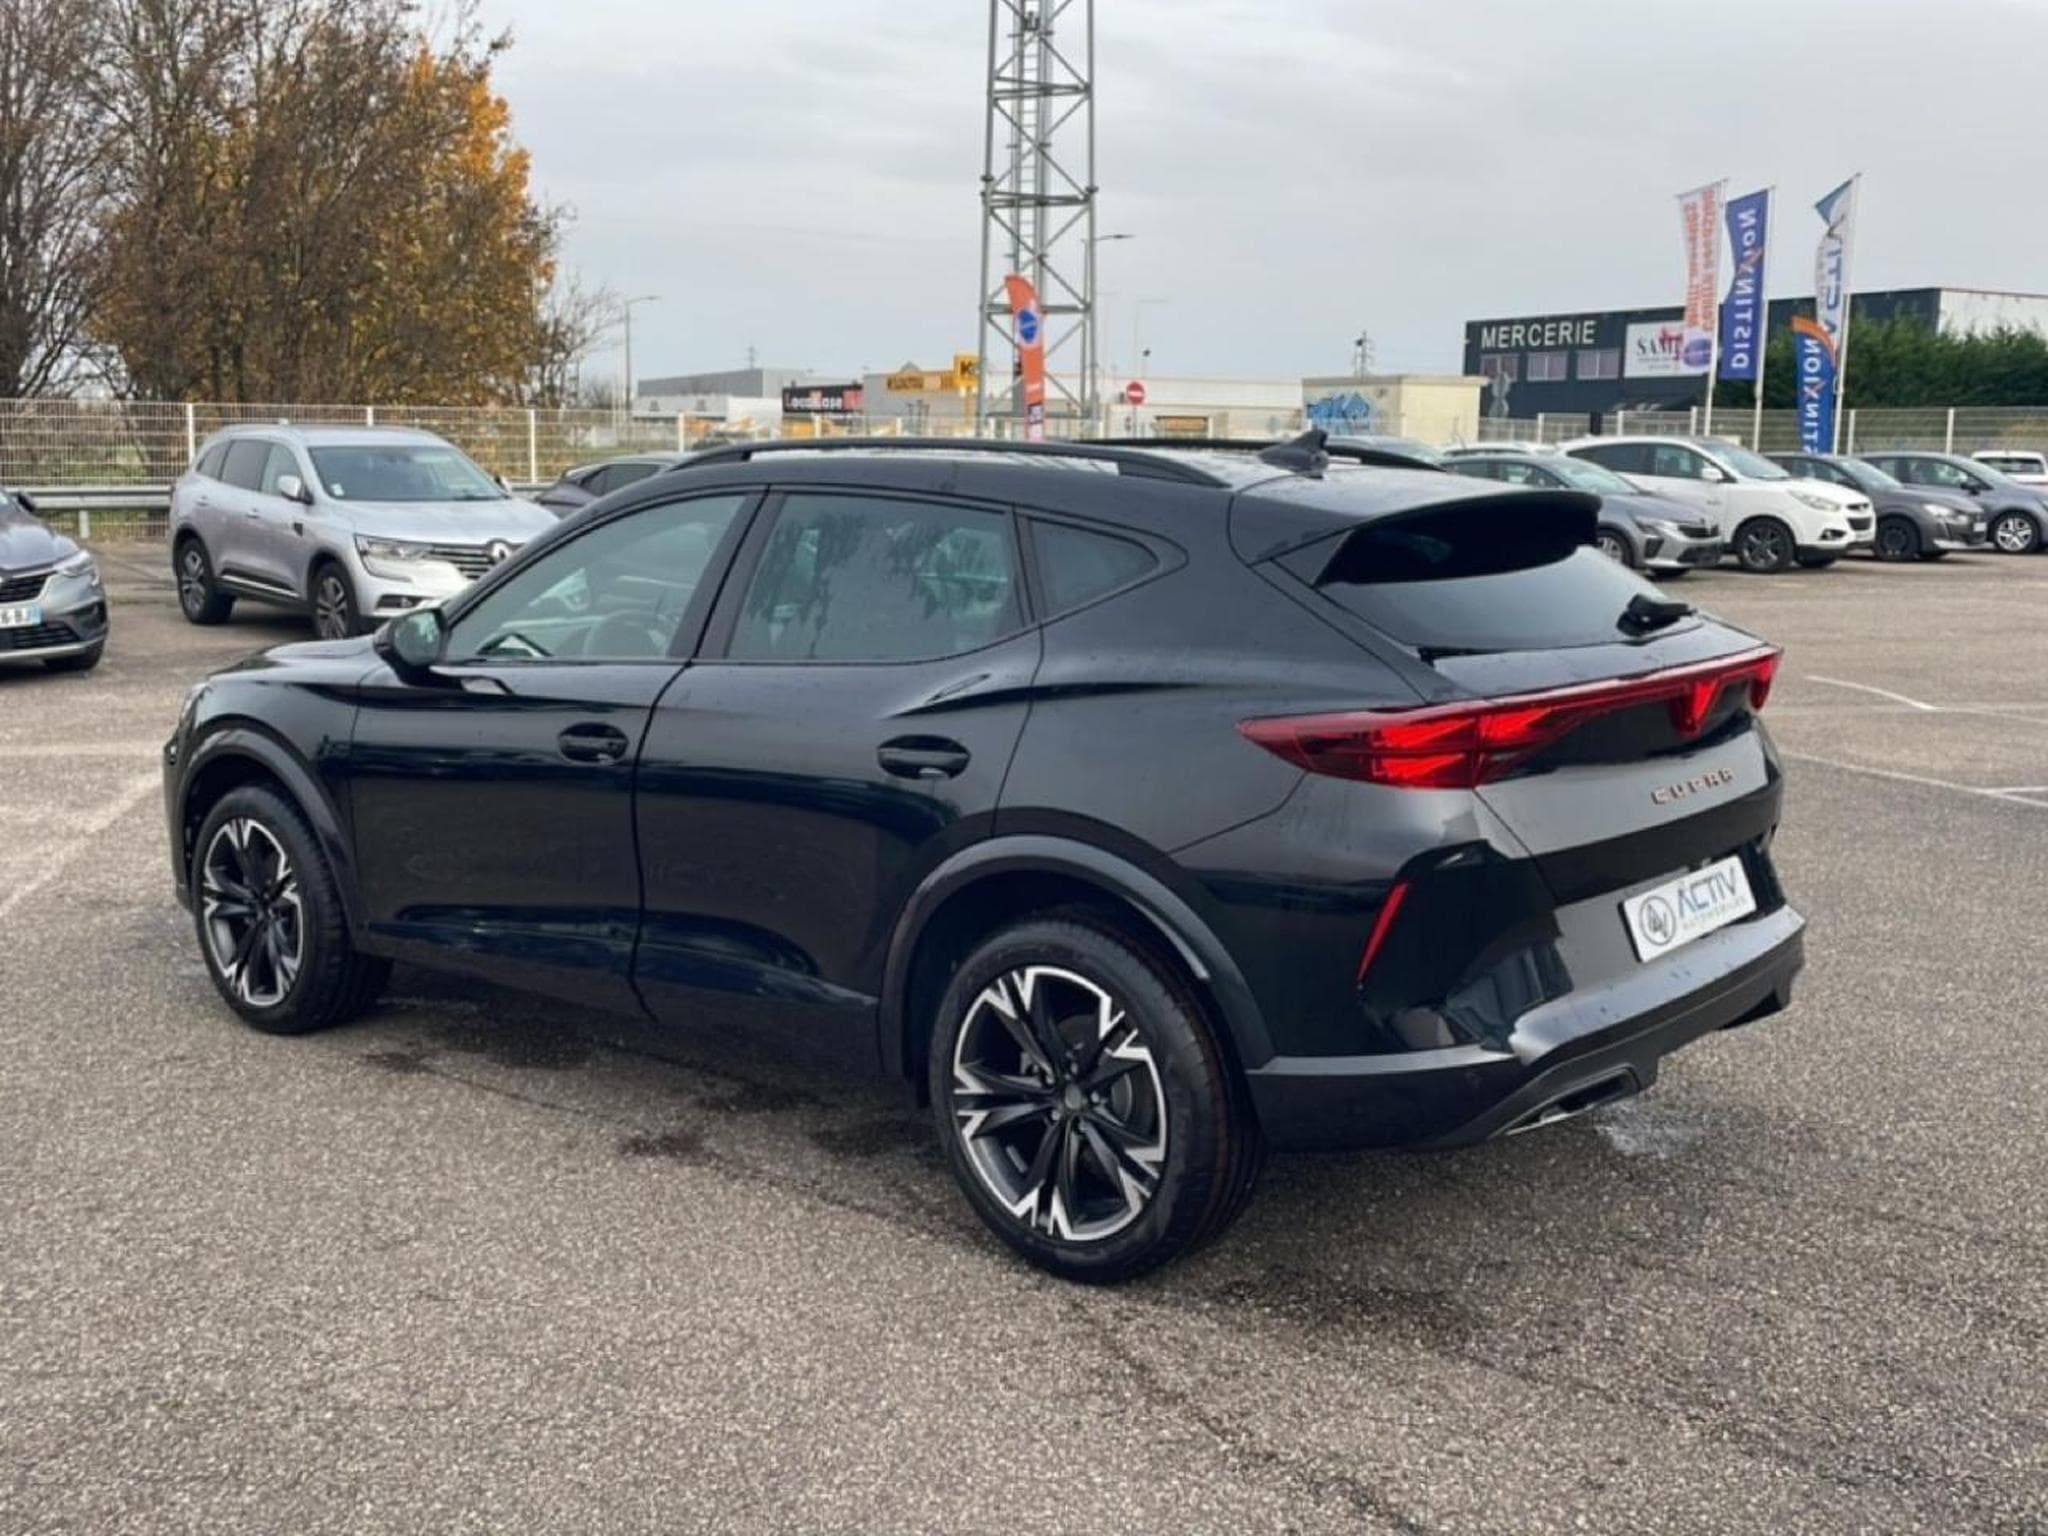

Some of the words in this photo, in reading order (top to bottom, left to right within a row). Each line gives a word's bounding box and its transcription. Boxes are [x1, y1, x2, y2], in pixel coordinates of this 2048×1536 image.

[1481, 320, 1597, 349] MERCERIE
[1650, 767, 1733, 805] CUPRA
[1677, 866, 1737, 919] ACTIV
